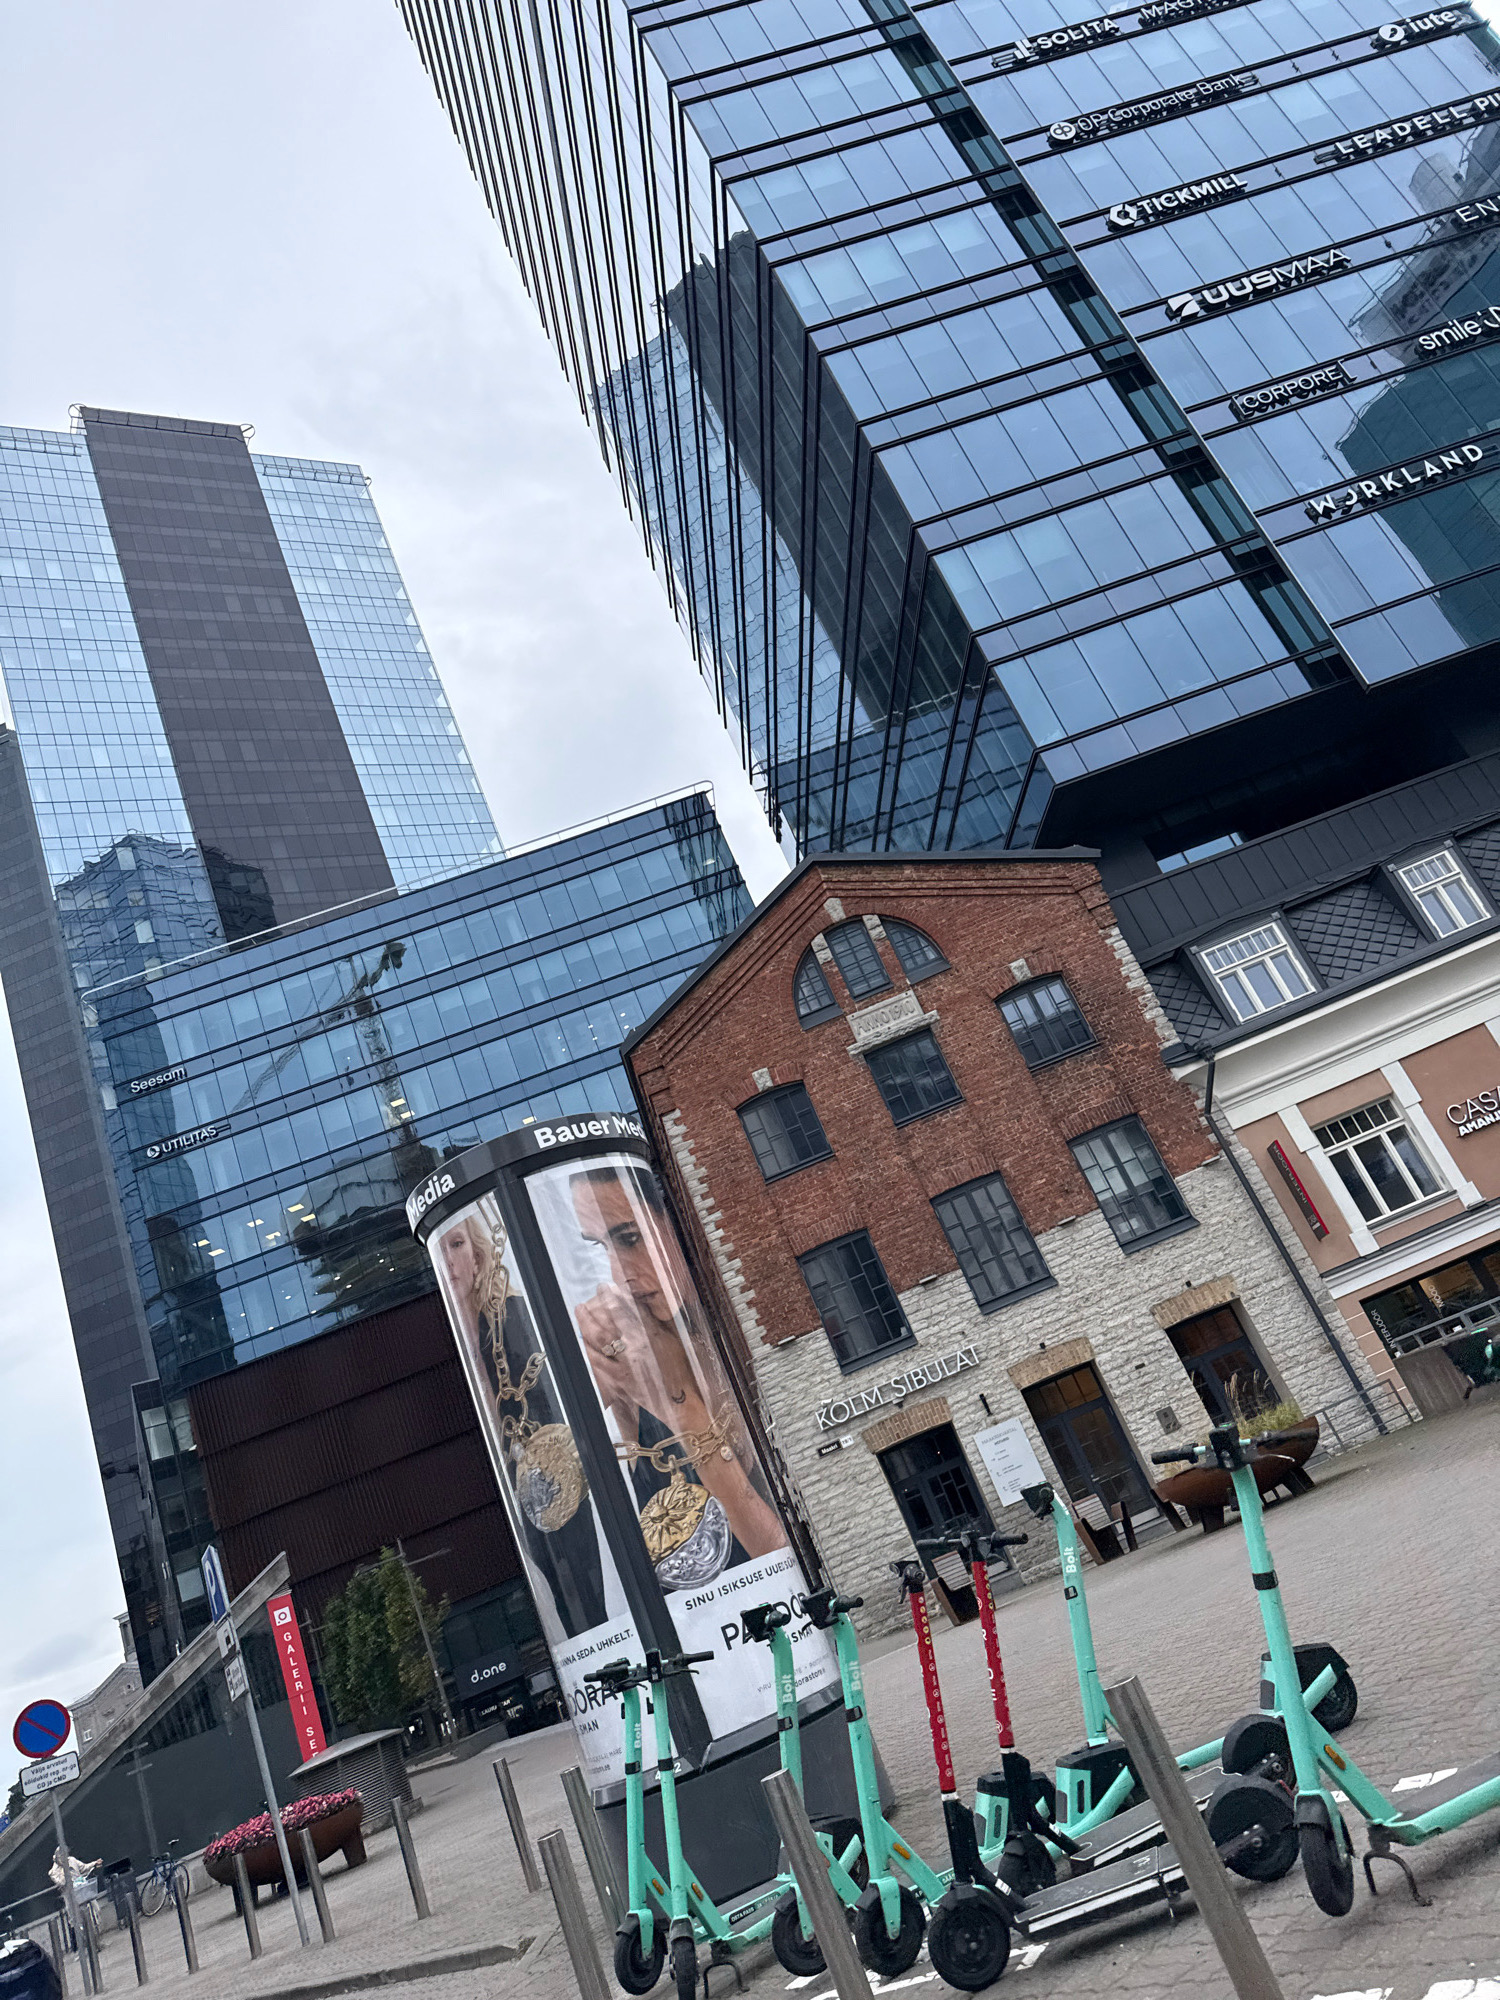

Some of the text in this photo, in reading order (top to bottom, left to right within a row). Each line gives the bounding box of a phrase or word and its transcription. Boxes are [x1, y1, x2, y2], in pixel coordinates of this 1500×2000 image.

[1037, 18, 1120, 50] SOLITA
[1405, 10, 1457, 33] iute
[1077, 73, 1246, 132] OP Corporate Bank
[1335, 106, 1468, 155] LEADELL
[1137, 172, 1248, 215] TICKMILL
[1455, 195, 1500, 223] EN
[1202, 248, 1351, 306] UUSMAA
[130, 1066, 186, 1094] Seesam
[162, 1125, 217, 1154] UTILITAS
[533, 1117, 610, 1149] Bauer
[406, 1172, 456, 1222] Media
[1426, 1283, 1444, 1309] MOOD
[815, 1343, 980, 1431] KÕLM SIBULAT
[1063, 1546, 1077, 1574] Bolt
[205, 1558, 220, 1615] P
[685, 1591, 715, 1611] SINU
[717, 1571, 765, 1598] ISIKSUSE
[576, 1646, 597, 1661] SEDA
[596, 1629, 635, 1652] UHKELT.
[283, 1631, 308, 1716] GALERII
[470, 1661, 507, 1684] d.one
[782, 1673, 794, 1703] Bolt
[849, 1660, 865, 1691] Bolt
[633, 1721, 643, 1750] Bolt
